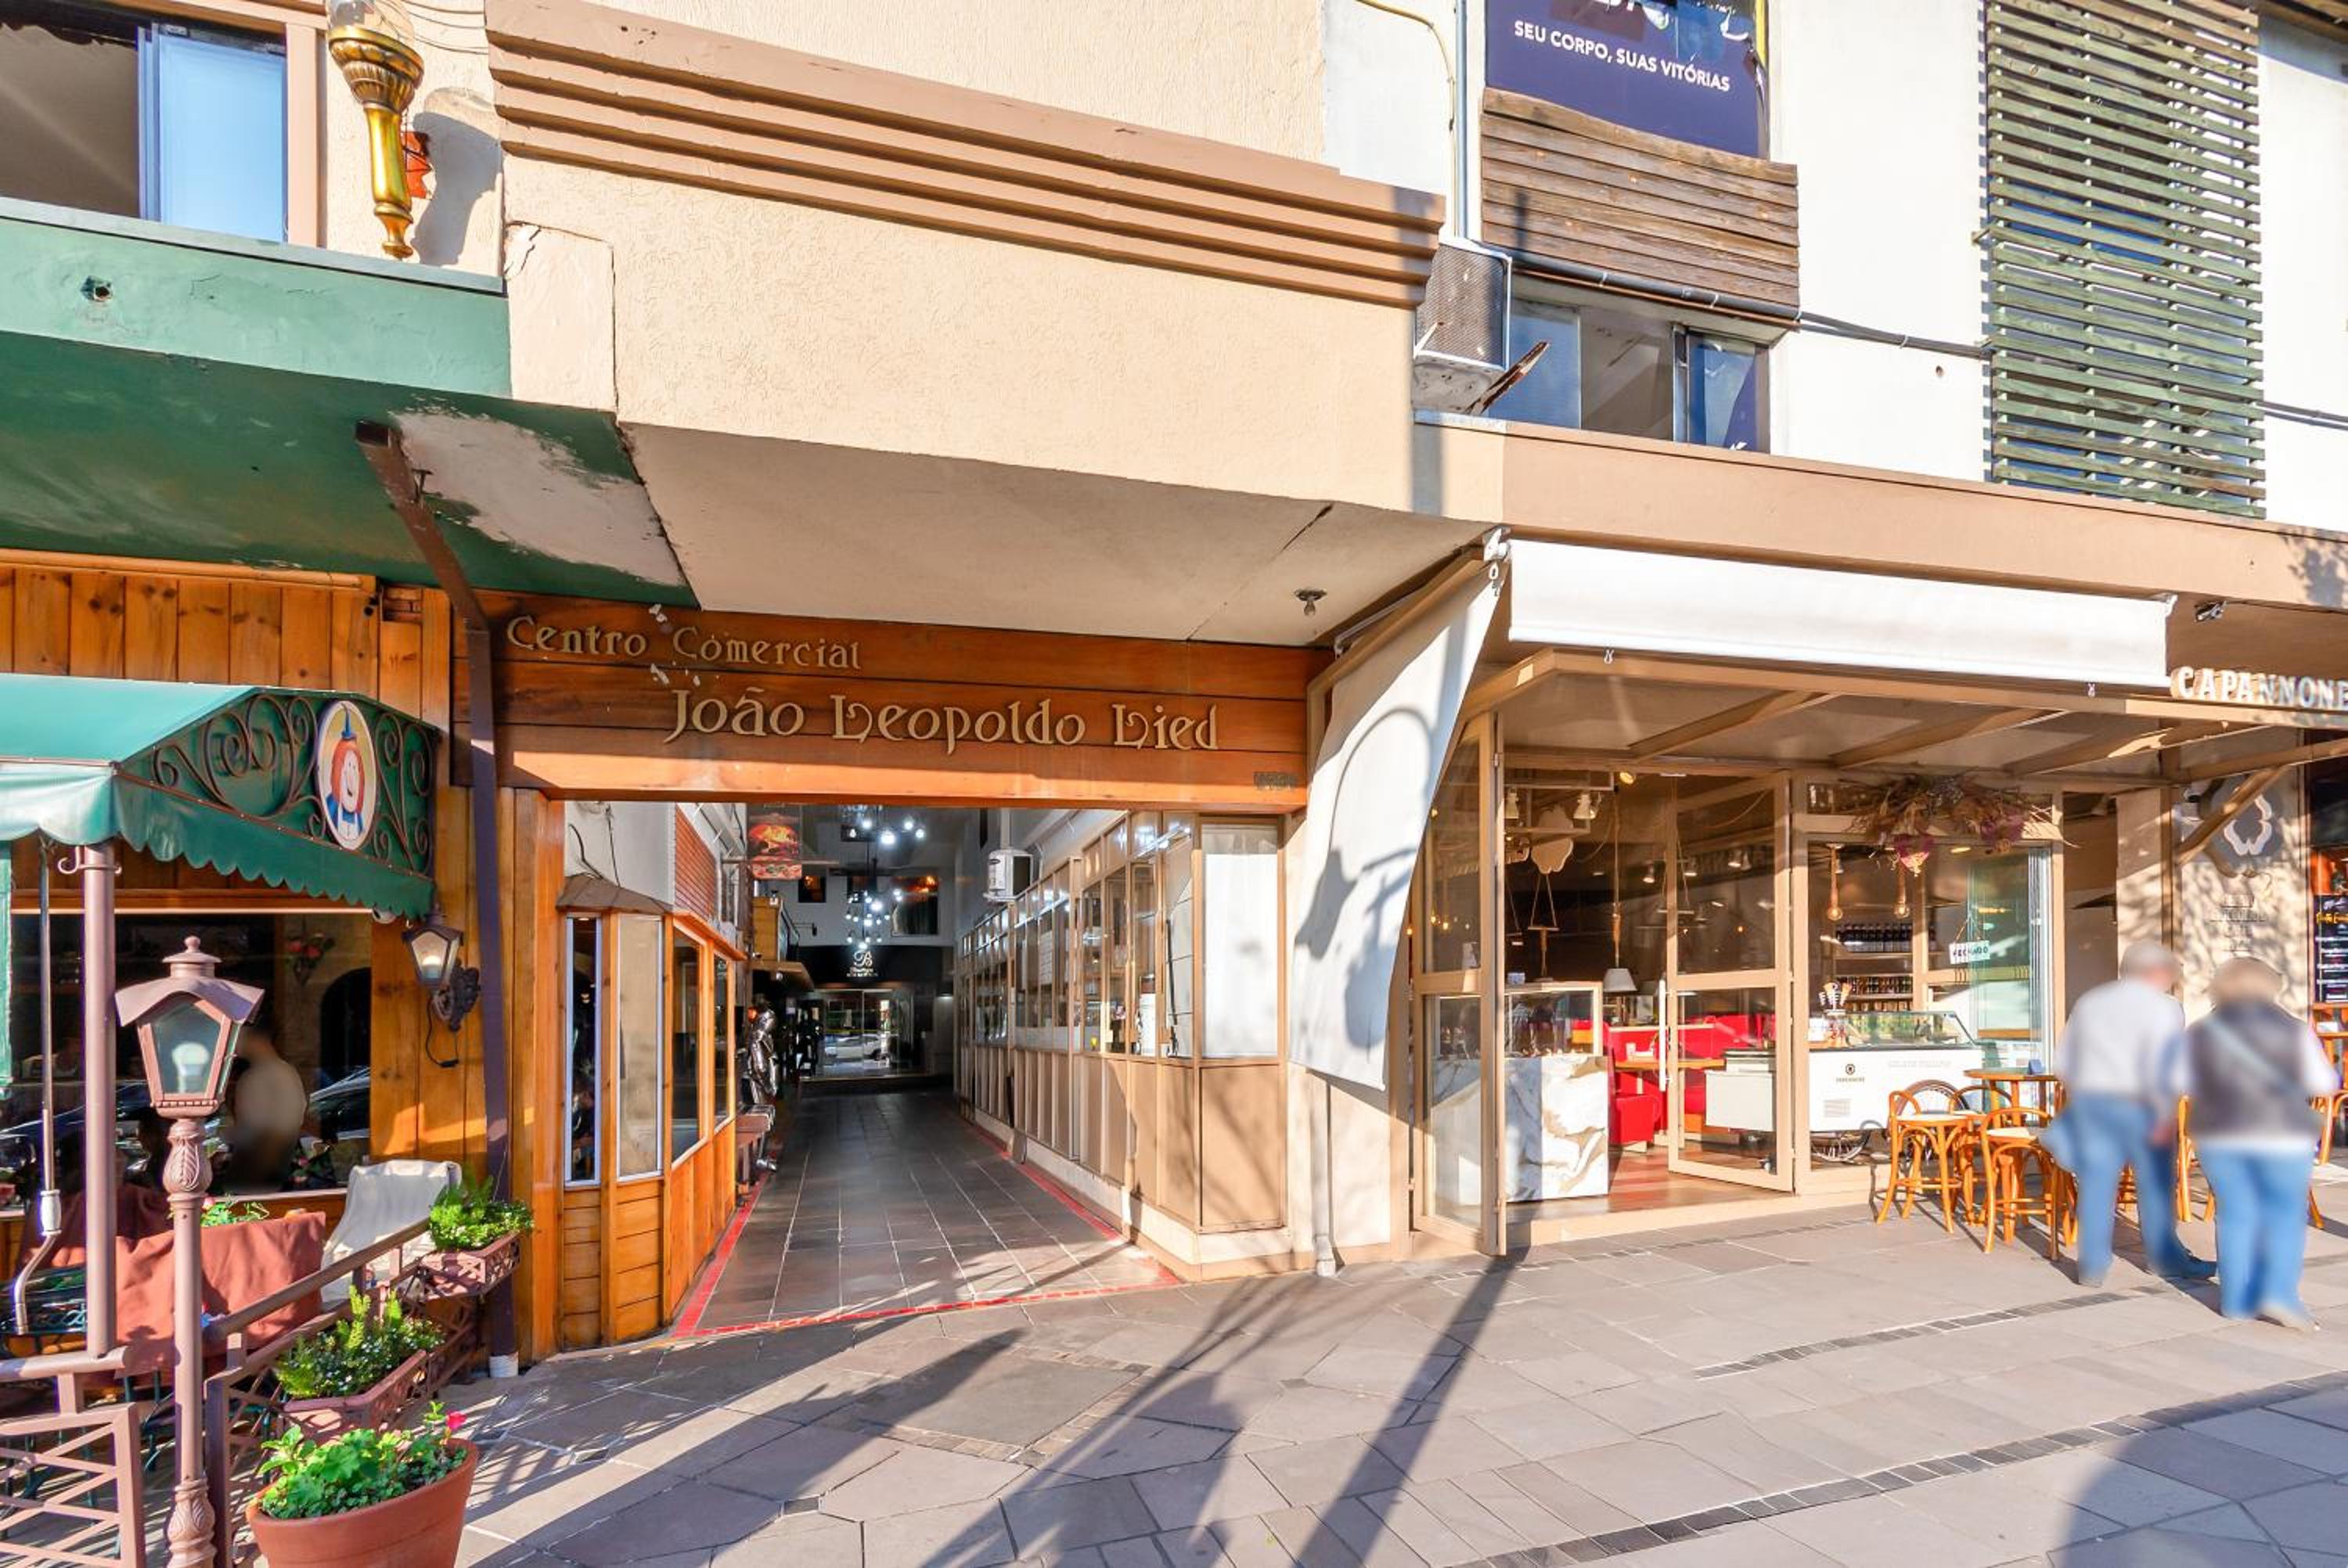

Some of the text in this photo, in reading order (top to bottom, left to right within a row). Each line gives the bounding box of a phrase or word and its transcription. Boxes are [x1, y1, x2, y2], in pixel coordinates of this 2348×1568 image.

[1514, 20, 1730, 92] SEU CORPO, SUAS VITÓRIAS
[506, 615, 862, 671] Centro Comercial
[2172, 666, 2348, 711] CAPANNONE
[663, 686, 1219, 756] João Leopoldo Lied
